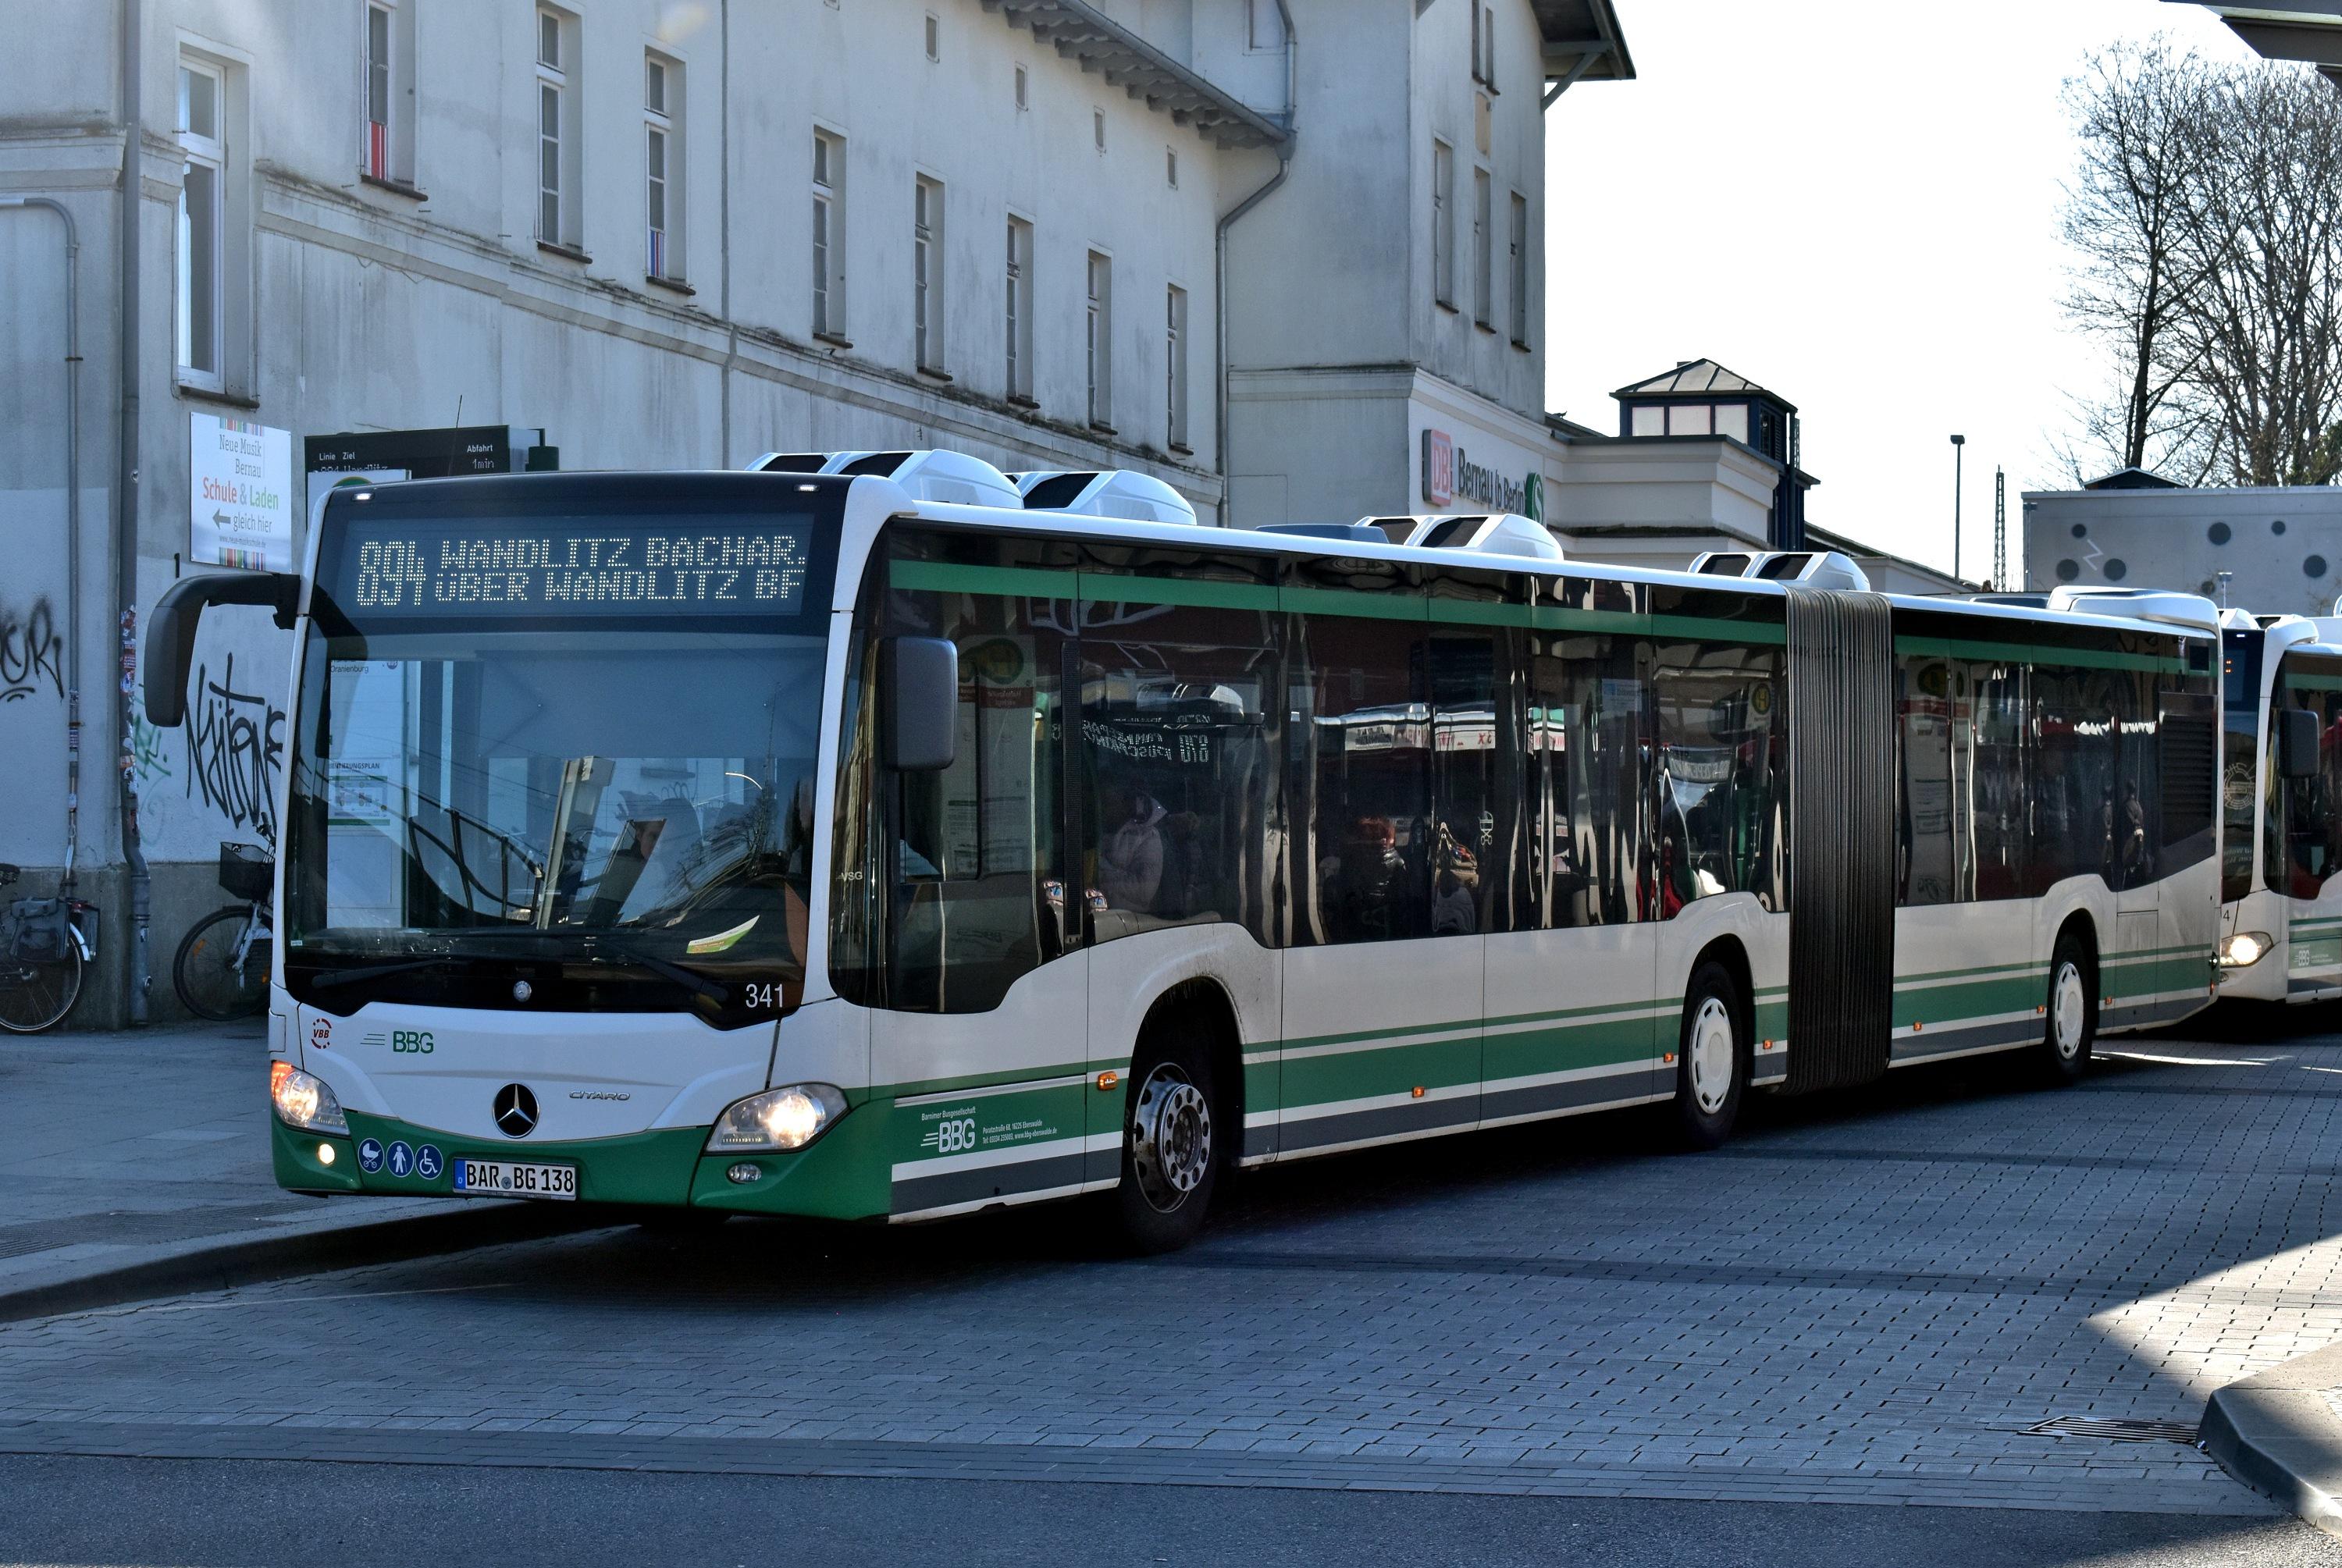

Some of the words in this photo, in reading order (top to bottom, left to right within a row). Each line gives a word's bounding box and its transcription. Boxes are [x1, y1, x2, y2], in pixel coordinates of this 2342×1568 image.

[219, 434, 239, 452] Neue
[240, 438, 262, 457] Musik
[342, 451, 356, 460] Ziel
[467, 444, 493, 453] Abfahrt
[235, 458, 262, 478] Bernau
[1433, 445, 1450, 494] DB
[1458, 447, 1493, 505] Bernau
[203, 477, 237, 504] Schule
[240, 482, 247, 506] &
[250, 485, 279, 510] Laden
[233, 512, 256, 532] gleich
[258, 516, 272, 533] hier
[441, 538, 631, 568] WANDLITZ
[646, 536, 806, 566] BACHAR.
[357, 542, 426, 606] 894
[435, 572, 529, 601] ÜBER
[545, 570, 739, 601] WANDLITZ
[755, 570, 805, 599] BF
[746, 983, 784, 1008] 341
[313, 1029, 330, 1039] VBB
[393, 1030, 434, 1054] BBG
[568, 1090, 631, 1102] CITARO
[921, 1112, 942, 1122] Barnimer
[942, 1106, 977, 1119] Busgesellschaft
[938, 1118, 976, 1153] BBG
[466, 1163, 500, 1189] BAR
[514, 1166, 536, 1191] BG
[541, 1168, 575, 1193] 138
